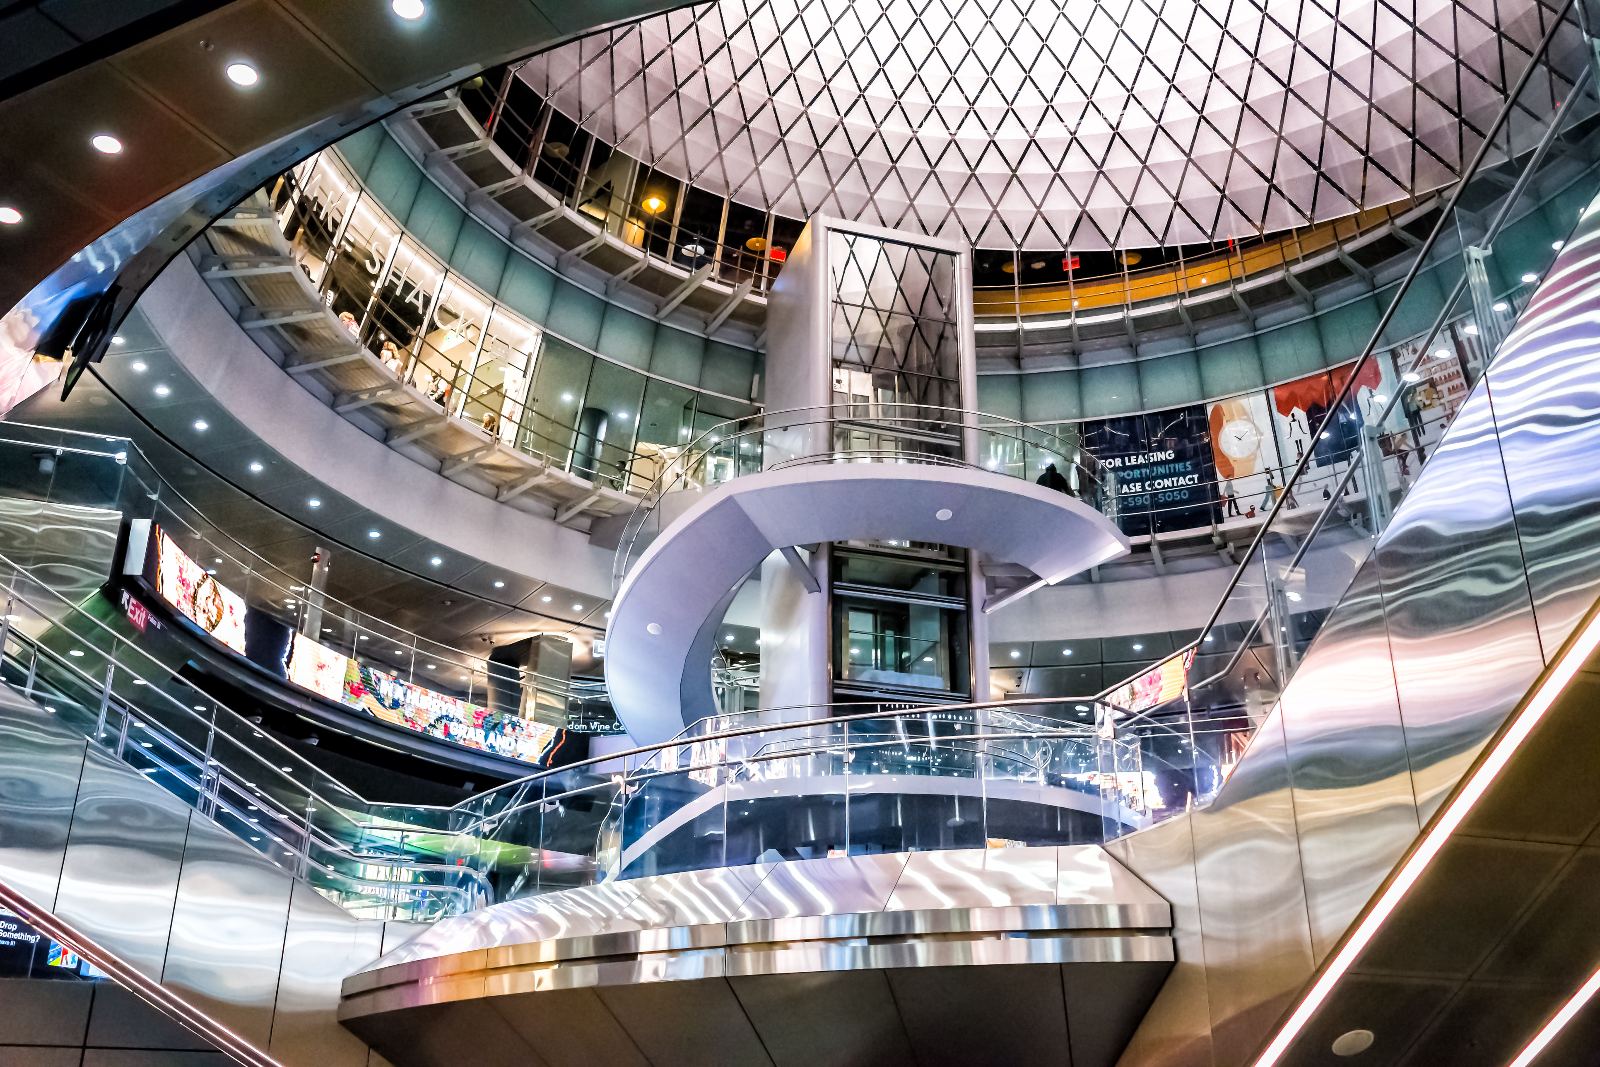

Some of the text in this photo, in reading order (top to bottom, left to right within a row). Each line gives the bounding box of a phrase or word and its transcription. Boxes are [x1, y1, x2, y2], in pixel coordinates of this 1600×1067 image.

[365, 241, 475, 339] SHACK
[1099, 450, 1175, 470] FOR LEASING
[1118, 462, 1191, 479] PORTUNITIES
[1117, 473, 1199, 494] ASE CONTACT
[1119, 490, 1189, 508] -590-5050
[127, 598, 146, 628] Exit
[567, 721, 588, 730] dom
[589, 721, 611, 732] Wine
[0, 921, 17, 931] Drop
[0, 930, 40, 943] Something?
